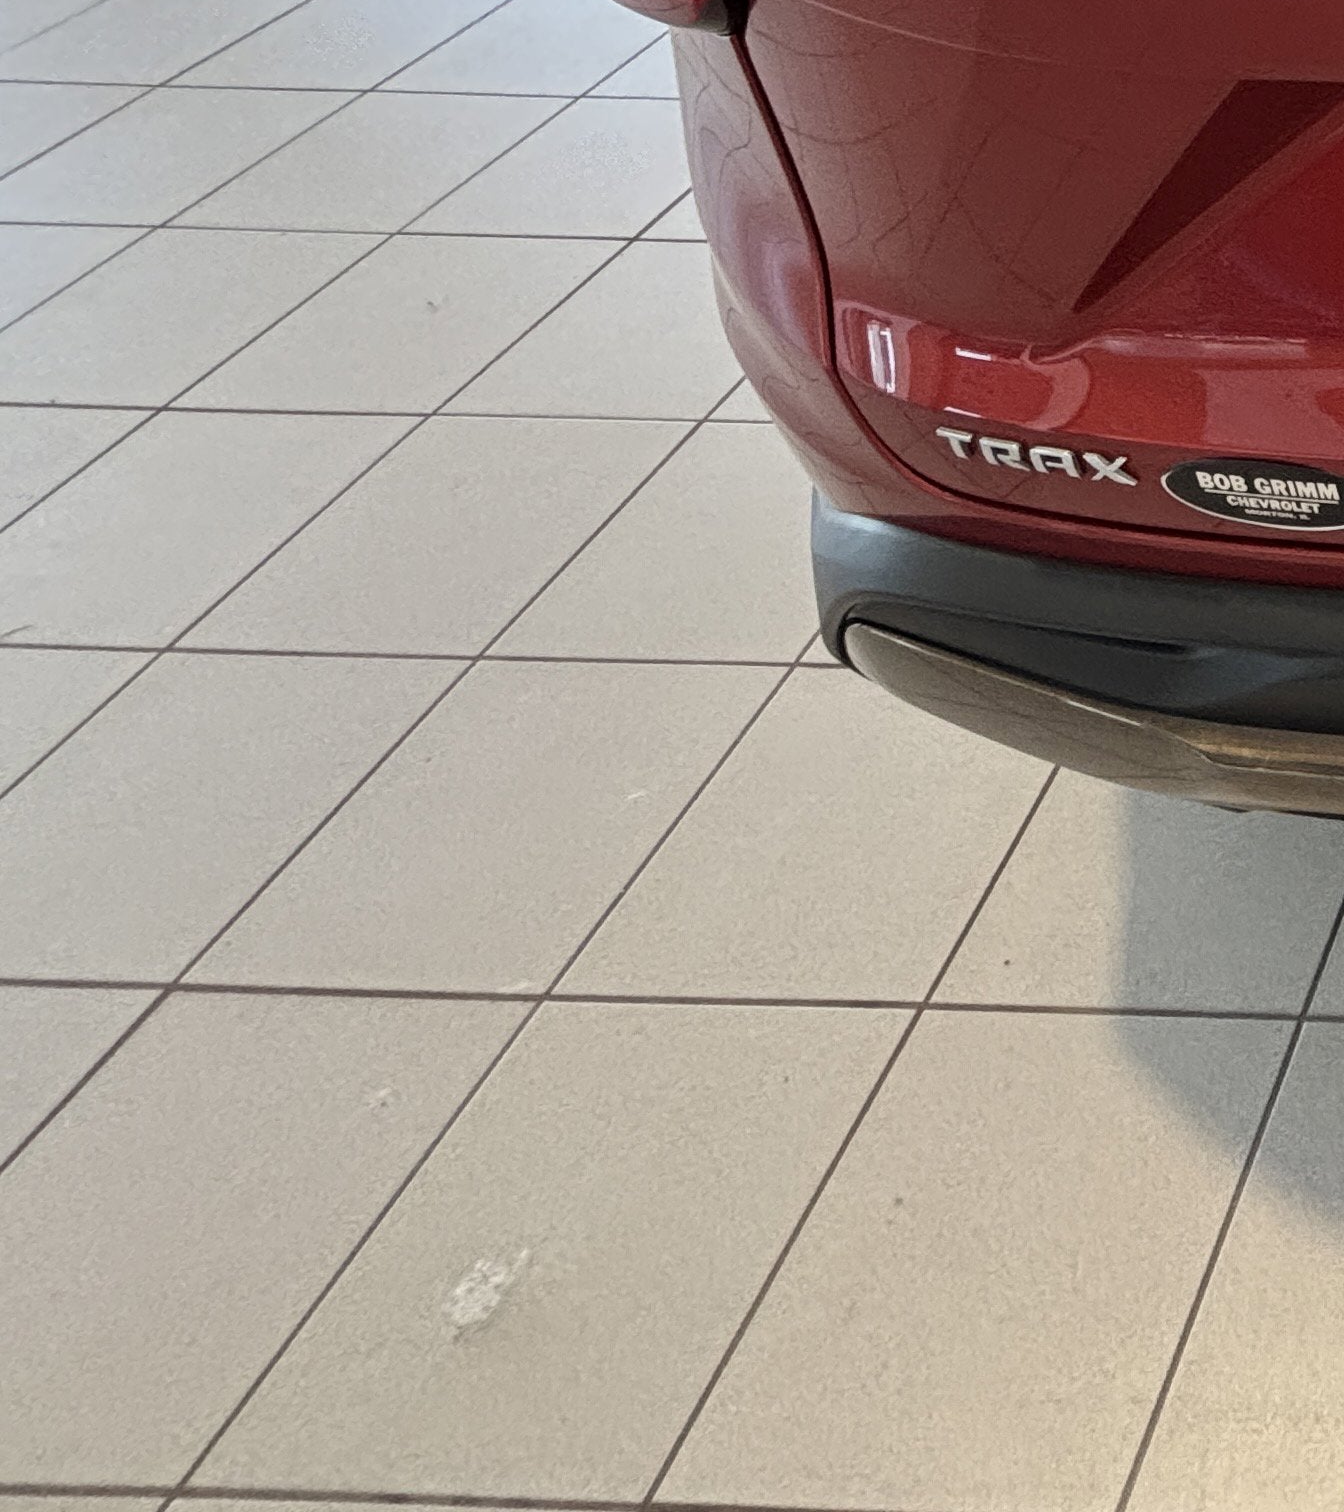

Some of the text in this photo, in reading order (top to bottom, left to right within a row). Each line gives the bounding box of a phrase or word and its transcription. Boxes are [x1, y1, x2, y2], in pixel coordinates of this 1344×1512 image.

[935, 425, 1138, 487] TRAX
[1195, 471, 1341, 501] BOB GRIMM
[1226, 495, 1321, 515] CHEVROLET
